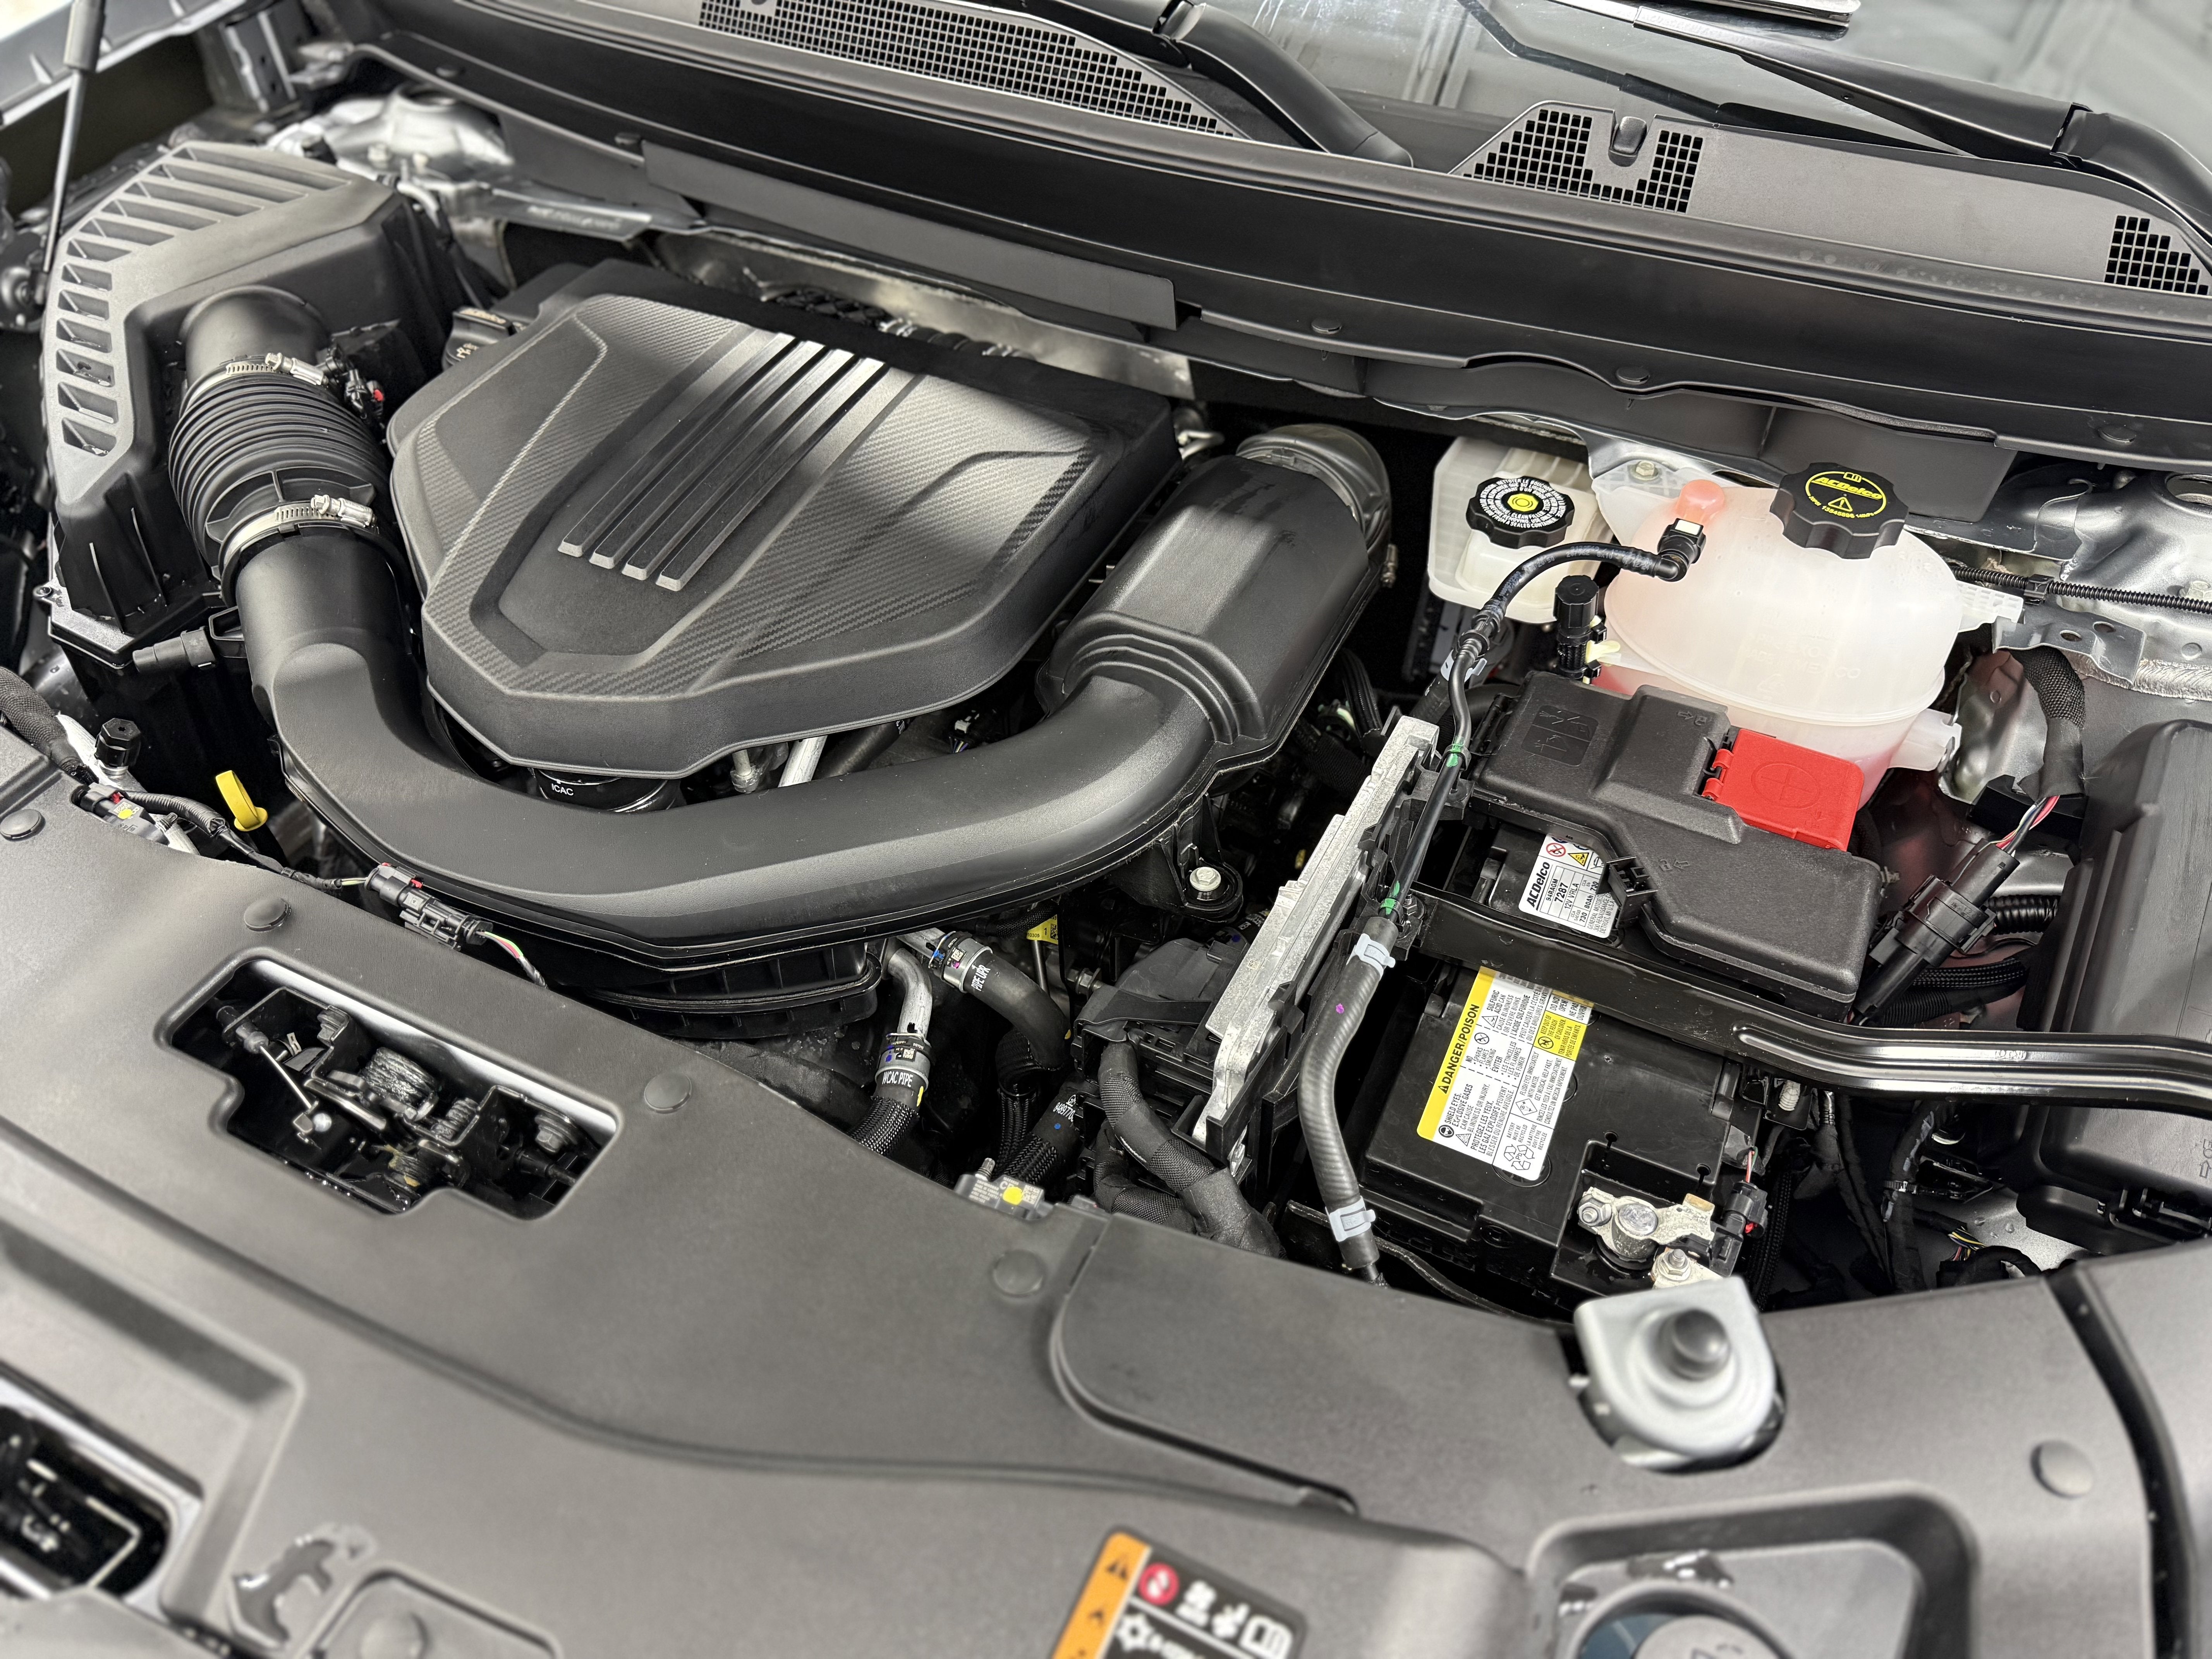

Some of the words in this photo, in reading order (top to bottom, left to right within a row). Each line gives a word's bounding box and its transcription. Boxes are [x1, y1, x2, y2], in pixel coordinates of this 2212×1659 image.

[1815, 477, 1882, 500] ACDelco
[552, 783, 574, 796] ICAC
[1527, 862, 1550, 907] ACDelco
[1554, 882, 1568, 902] 7287
[1567, 883, 1579, 898] VRLA
[1590, 881, 1599, 891] 730
[1564, 898, 1573, 909] 12V
[1579, 912, 1587, 922] 730
[1584, 895, 1594, 908] 80Ah
[1587, 912, 1598, 929] GENERAL
[1599, 916, 1611, 934] DETROIT,
[1044, 927, 1047, 936] 1
[975, 964, 991, 979] UPR
[971, 975, 985, 991] PIPE
[1486, 990, 1499, 1011] SULFURIC
[1493, 1002, 1503, 1014] ACID
[1498, 994, 1506, 1003] CAN
[1496, 1016, 1506, 1030] CAUSE
[1501, 994, 1514, 1017] BLINDNESS
[1505, 1010, 1516, 1026] SEVERE
[1510, 1019, 1521, 1036] L'ACIDE
[1516, 994, 1530, 1020] SULFURIQUE
[1522, 1011, 1533, 1028] CAUSER
[1518, 1027, 1527, 1039] PEUT
[1528, 1025, 1536, 1035] DES
[1540, 1025, 1548, 1035] KEEP
[1549, 1019, 1558, 1031] REACH
[1442, 1004, 1479, 1084] DANGER/POISON
[1473, 1046, 1483, 1062] SPARKS
[1479, 1049, 1489, 1065] FLAMES
[1485, 1048, 1496, 1066] SMOKING
[1510, 1047, 1522, 1066] FLAMMES
[1489, 1056, 1503, 1073] ÉVITER
[1500, 1064, 1508, 1073] LES
[1515, 1056, 1525, 1071] FUMER
[1527, 1051, 1539, 1075] IMMEDIATELY
[882, 1071, 899, 1085] WCAC
[898, 1072, 914, 1087] PIPE
[1523, 1074, 1532, 1084] EYES
[1536, 1078, 1547, 1094] MEDICAL
[1495, 1085, 1507, 1106] PEUVENT
[1519, 1083, 1528, 1096] FLUSH
[1527, 1087, 1535, 1098] WITH
[1053, 1102, 1076, 1122] 8489770
[1444, 1106, 1456, 1124] SHIELD
[1451, 1093, 1462, 1106] EYES.
[1451, 1099, 1467, 1127] EXPLOSIVE
[1462, 1084, 1473, 1100] GASES
[1463, 1104, 1474, 1120] CAUSE
[1483, 1101, 1494, 1114] YEUX.
[1467, 1107, 1481, 1132] BLINDNESS
[1479, 1114, 1488, 1125] LES
[1485, 1106, 1500, 1133] EXPLOSIFS
[1496, 1109, 1507, 1128] RENDRE
[1544, 1105, 1555, 1124] CONSULTEZ
[1460, 1119, 1468, 1130] CAN
[1493, 1128, 1501, 1136] OU
[1506, 1122, 1515, 1138] BATTERY
[1527, 1124, 1537, 1140] BATTERIE
[1482, 1132, 1491, 1143] GAZ
[1518, 1124, 1527, 1143] RECYCLED
[1478, 1143, 1487, 1154] LES
[1486, 1135, 1498, 1156] BLESSER
[1515, 1152, 1522, 1160] Pb
